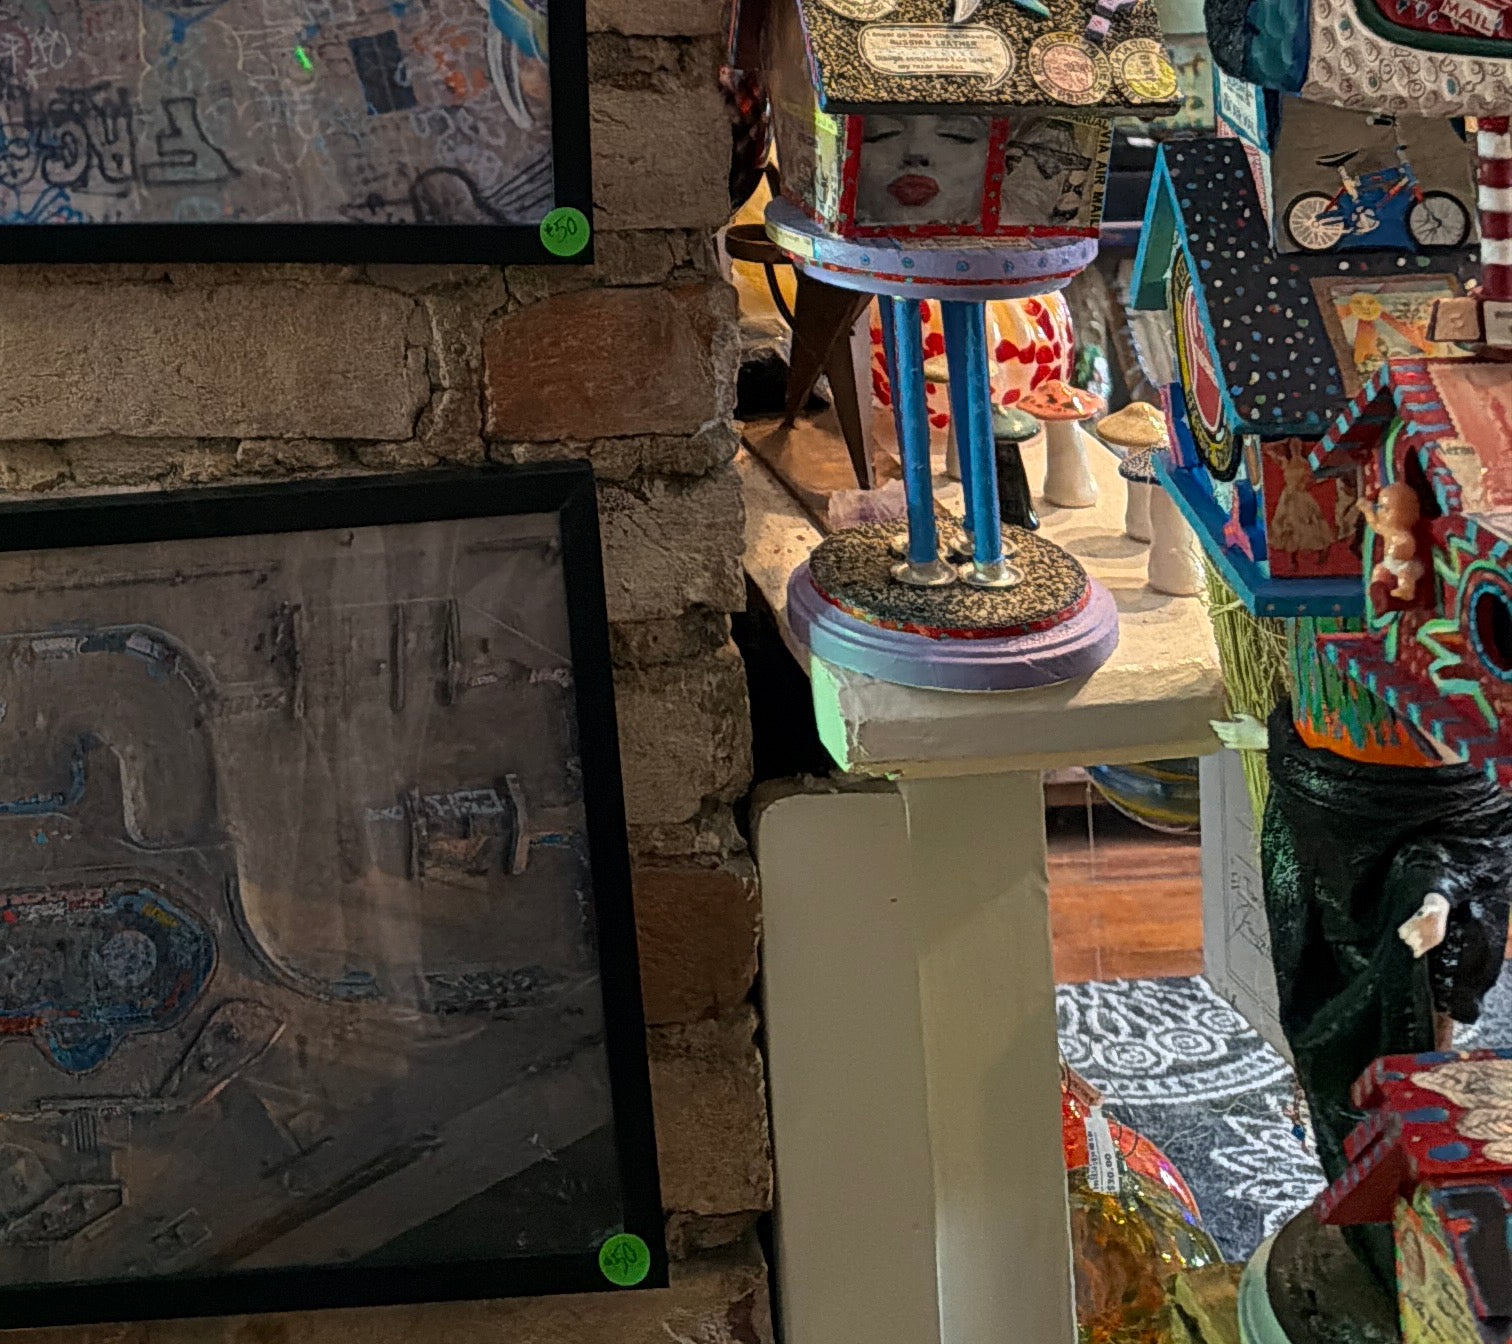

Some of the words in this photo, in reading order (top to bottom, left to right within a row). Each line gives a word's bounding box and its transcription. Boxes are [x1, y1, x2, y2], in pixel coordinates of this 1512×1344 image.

[1098, 130, 1112, 153] VIA
[1094, 161, 1107, 185] AIR
[1089, 192, 1104, 226] MAIL
